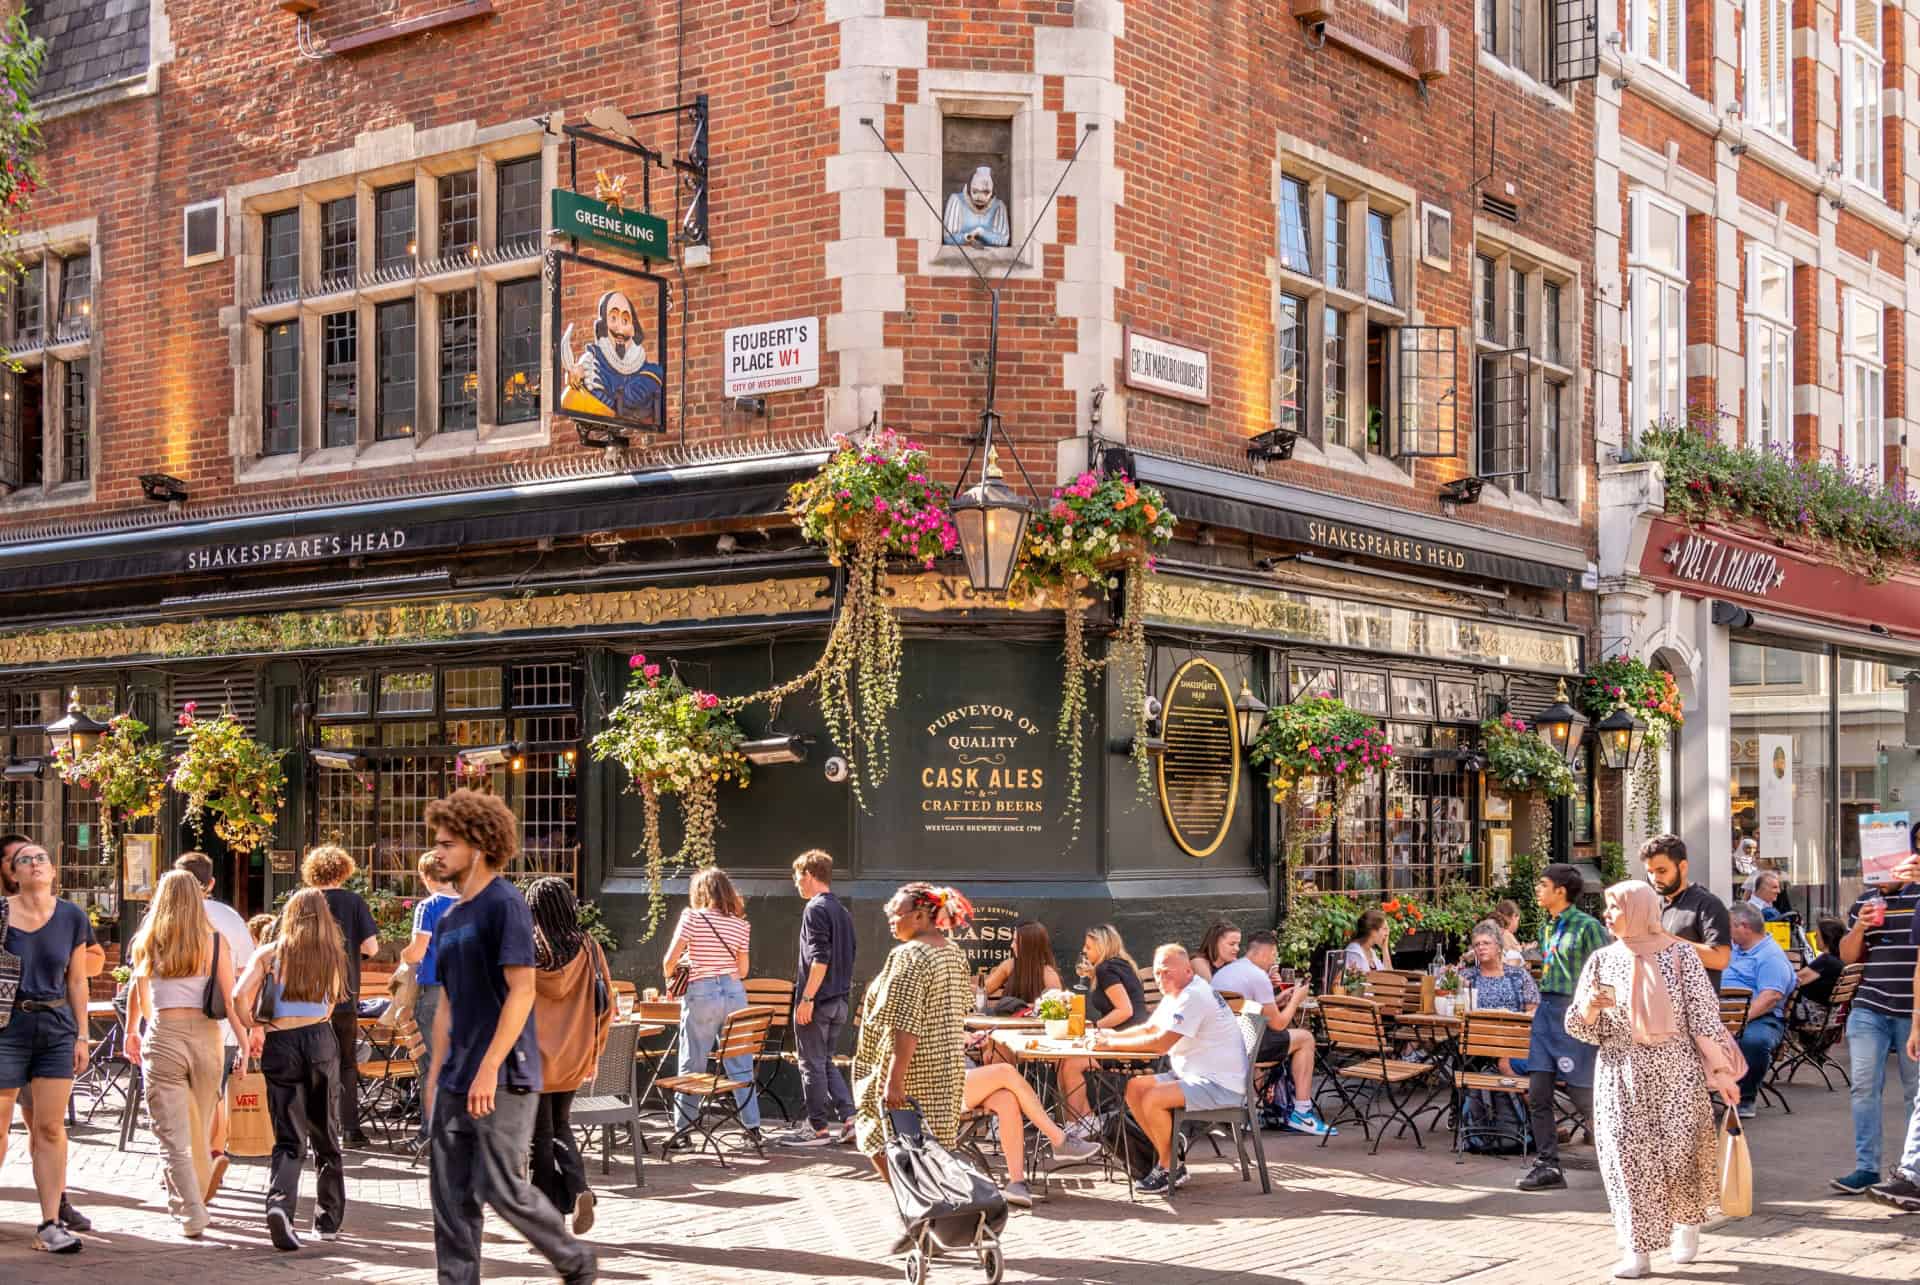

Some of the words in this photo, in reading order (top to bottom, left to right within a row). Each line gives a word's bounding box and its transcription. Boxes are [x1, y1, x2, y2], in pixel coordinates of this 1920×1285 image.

[575, 209, 621, 233] GREENE
[624, 223, 654, 242] KING
[732, 326, 807, 352] FOUBERT'S
[732, 352, 774, 373] PLACE
[779, 348, 799, 368] W1
[1131, 348, 1152, 377] GRAT
[732, 383, 747, 392] CITY
[747, 381, 755, 390] OF
[758, 376, 802, 388] WESTMINSTER
[188, 537, 341, 569] SHAKESPEARE'S
[350, 531, 406, 553] HEAD
[1309, 522, 1422, 561] SHAKESPEARE'S
[1428, 547, 1465, 569] HEAD
[1677, 535, 1719, 581] PRET
[1709, 544, 1728, 584] A
[1721, 547, 1777, 596] MANGER
[927, 704, 1014, 737] PURVEYOR
[1017, 717, 1040, 736] OF
[948, 736, 1018, 750] QUALITY
[921, 767, 980, 788] CASK
[988, 767, 1044, 788] ALES
[921, 800, 991, 812] CRAFTED
[996, 800, 1043, 812] BEERS
[978, 790, 987, 798] &
[925, 824, 965, 832] WESTGATE
[966, 824, 1001, 832] BREWERY
[1004, 824, 1024, 832] SINCE
[967, 949, 1011, 960] RITISH
